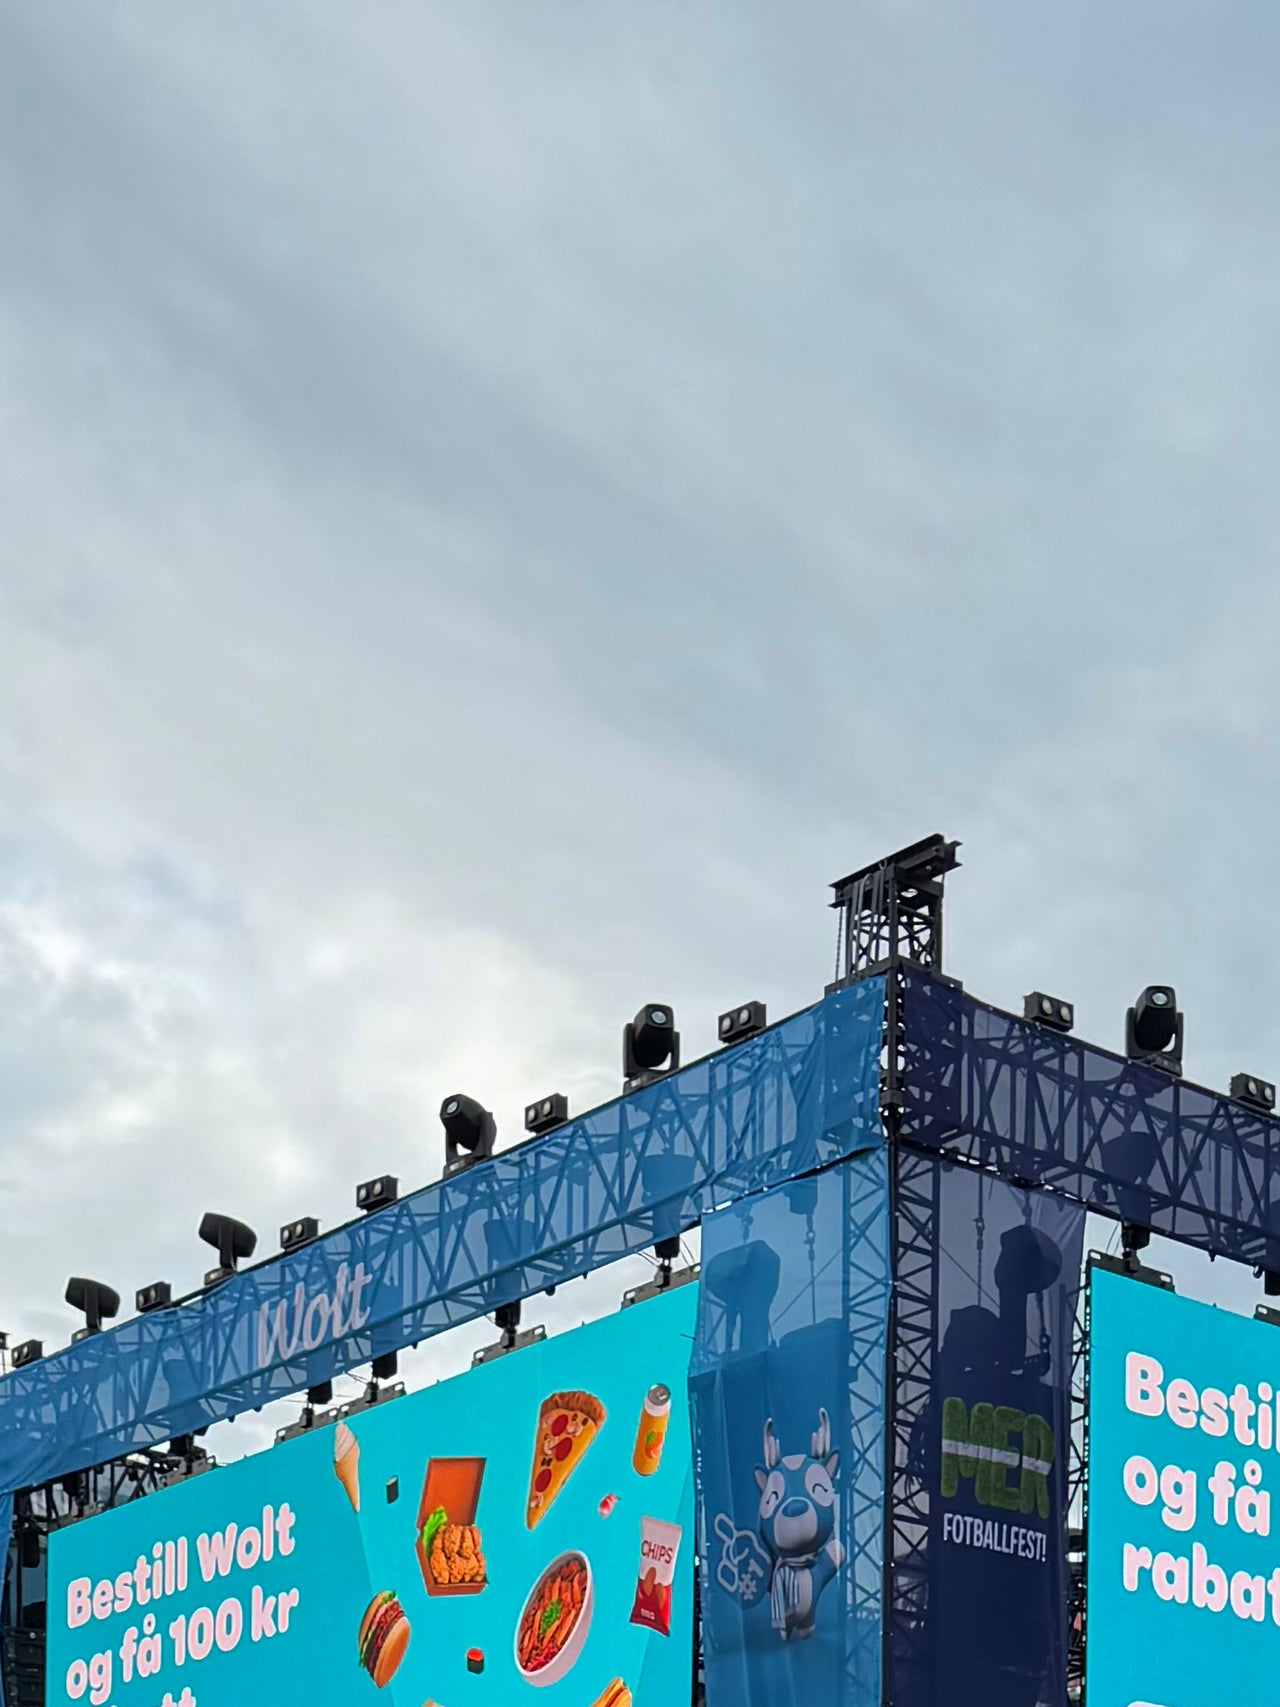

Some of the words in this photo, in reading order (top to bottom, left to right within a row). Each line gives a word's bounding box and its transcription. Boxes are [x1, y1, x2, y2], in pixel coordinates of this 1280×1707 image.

[259, 1261, 372, 1369] Wolt
[941, 1397, 1054, 1520] MER
[1123, 1455, 1197, 1533] og
[1207, 1458, 1271, 1539] få
[67, 1534, 188, 1630] Bestill
[195, 1502, 297, 1580] Wolt
[640, 1539, 673, 1564] CHIPS
[943, 1512, 1047, 1563] FOTBALLFEST!
[67, 1643, 113, 1705] og
[119, 1615, 164, 1678] få
[170, 1599, 244, 1659] 100
[251, 1583, 299, 1641] kr
